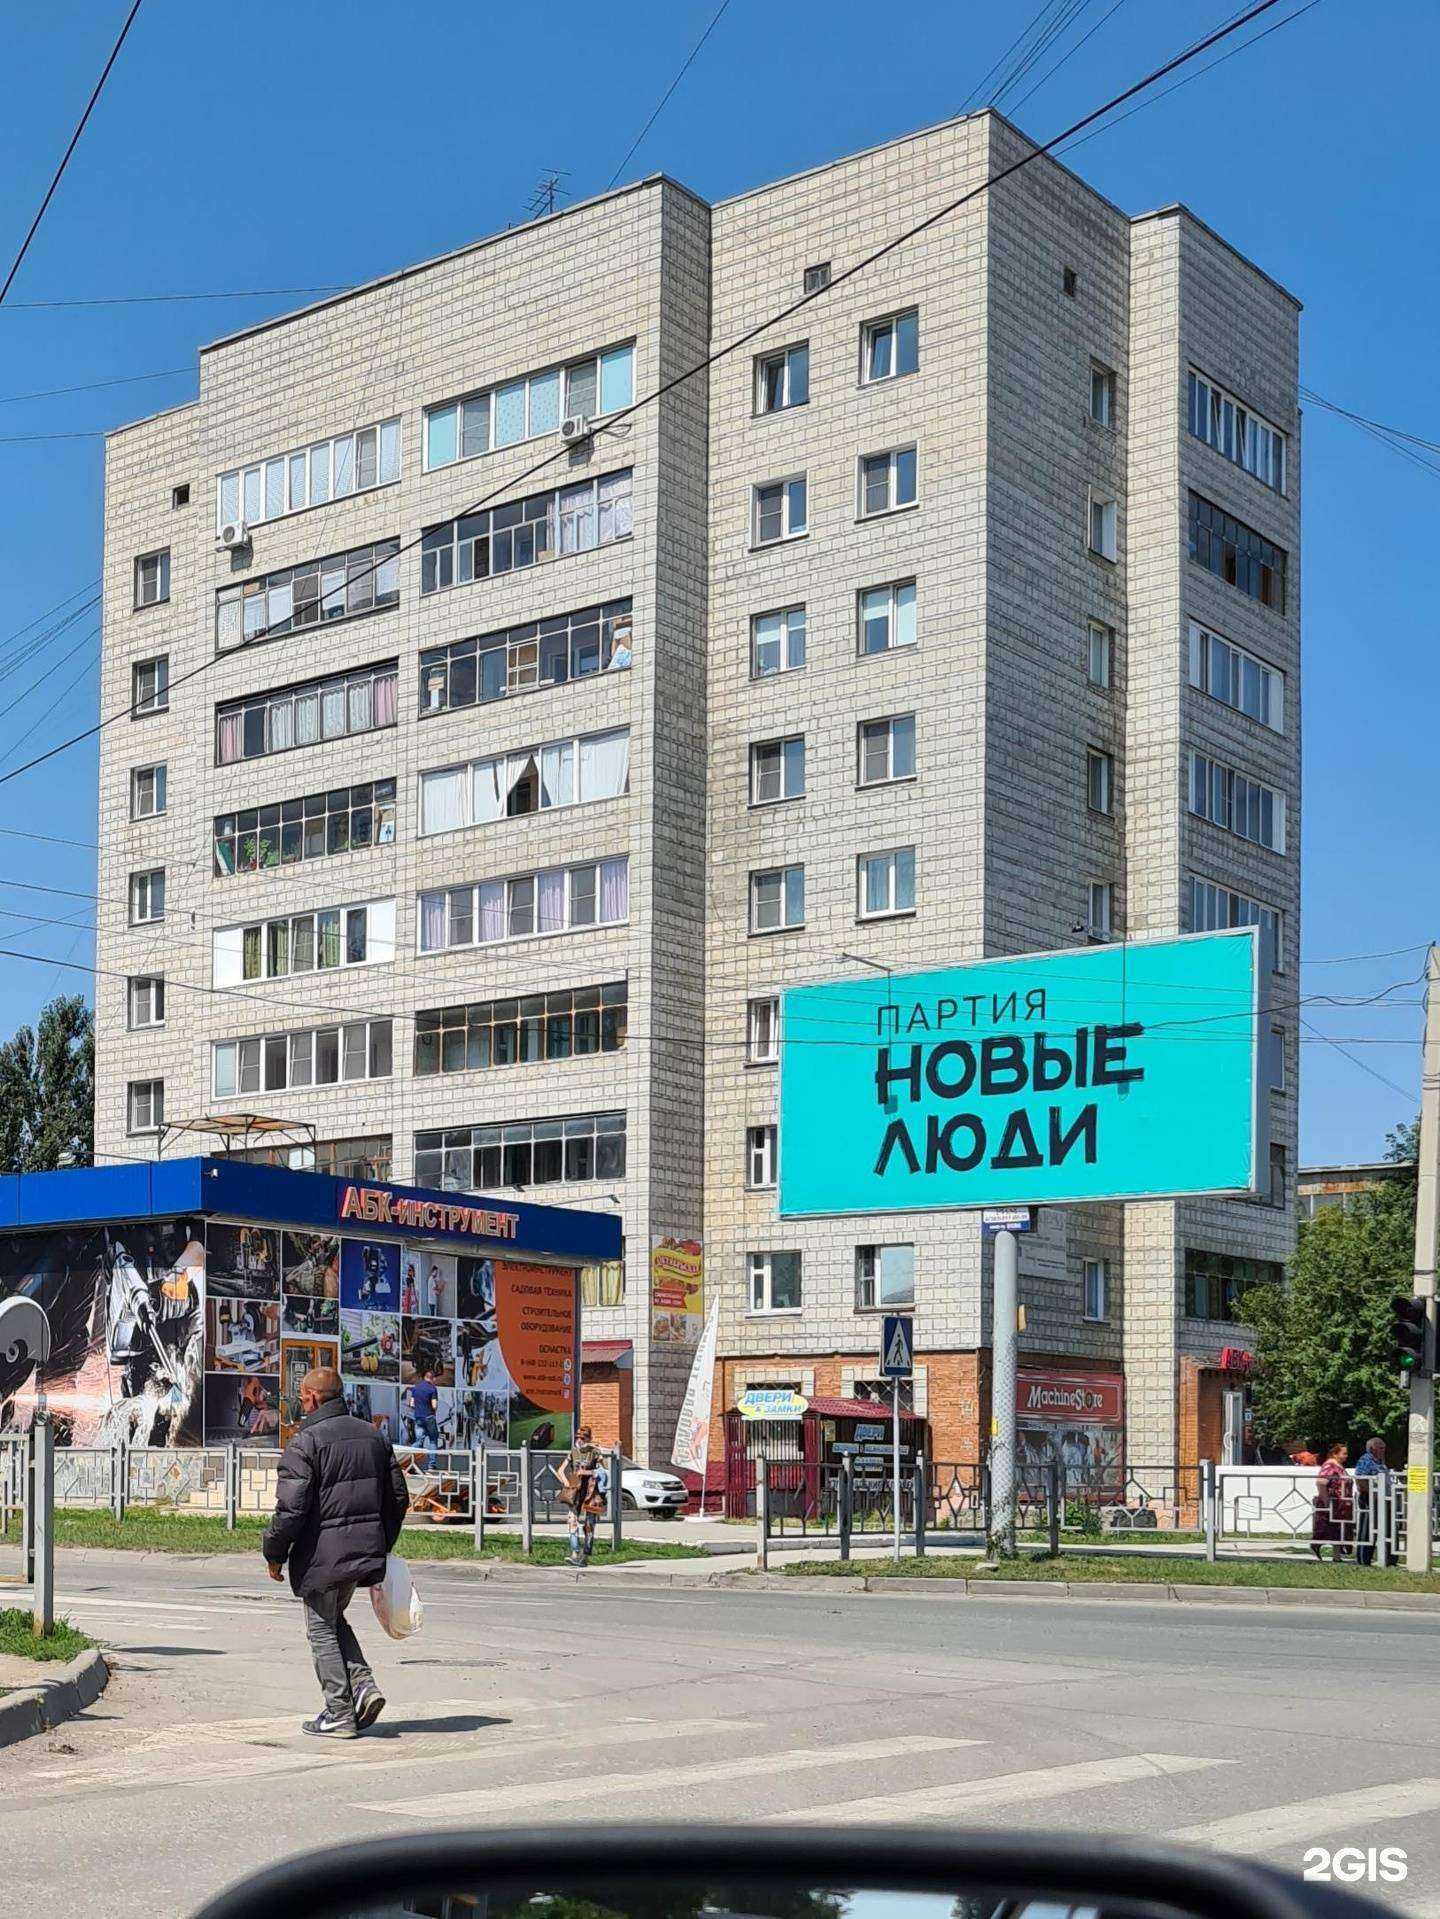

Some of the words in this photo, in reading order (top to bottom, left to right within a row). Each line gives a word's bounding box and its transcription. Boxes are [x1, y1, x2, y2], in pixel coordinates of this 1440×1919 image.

[877, 988, 1046, 1036] ПАРТИЯ
[875, 1022, 1144, 1105] НОВЫЕ
[873, 1103, 1098, 1177] ЛЮДИ
[340, 1185, 520, 1239] АБК-ИНСТРУМЕНТ
[745, 1392, 792, 1405] ДВЕРИ
